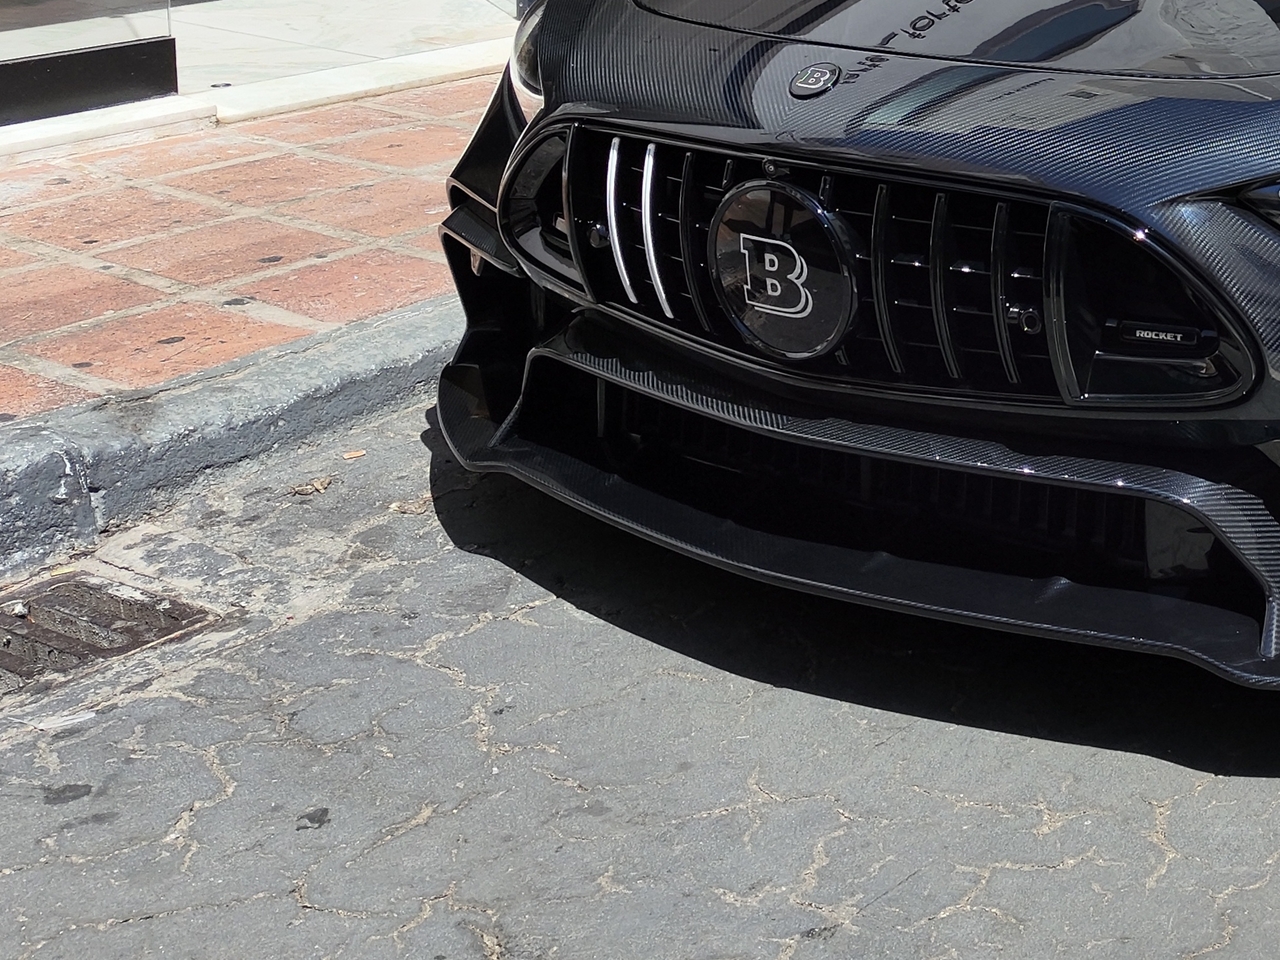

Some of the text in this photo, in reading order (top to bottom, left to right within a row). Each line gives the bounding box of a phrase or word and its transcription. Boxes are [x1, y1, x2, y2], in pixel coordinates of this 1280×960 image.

[796, 68, 830, 89] B
[740, 233, 814, 319] B
[1135, 329, 1183, 342] ROCKET
